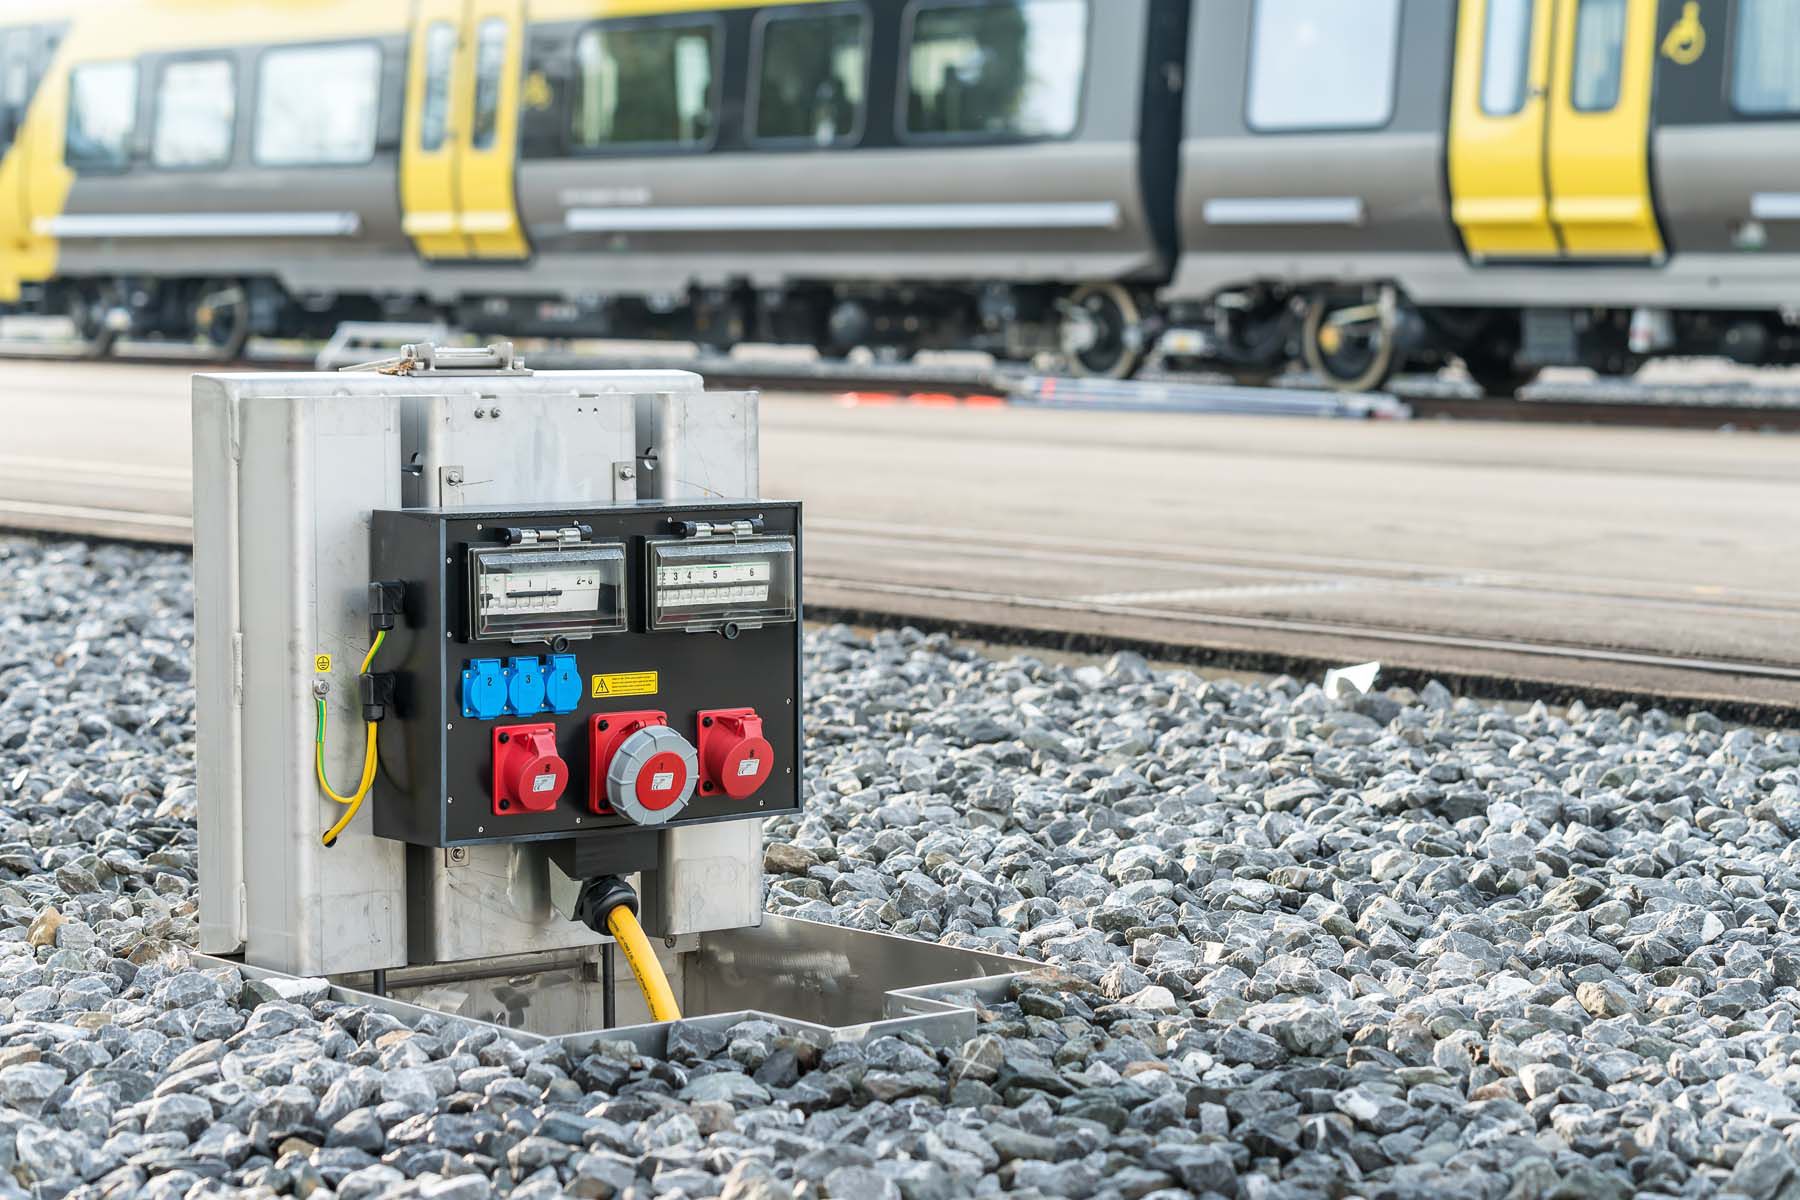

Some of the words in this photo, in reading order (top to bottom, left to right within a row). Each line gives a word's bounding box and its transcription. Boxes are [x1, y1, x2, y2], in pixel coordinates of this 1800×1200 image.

[673, 572, 678, 581] 3
[687, 571, 692, 579] 4
[713, 570, 718, 579] 5
[749, 568, 754, 577] 6
[525, 674, 531, 684] 3
[562, 672, 568, 681] 4
[487, 677, 493, 686] 2
